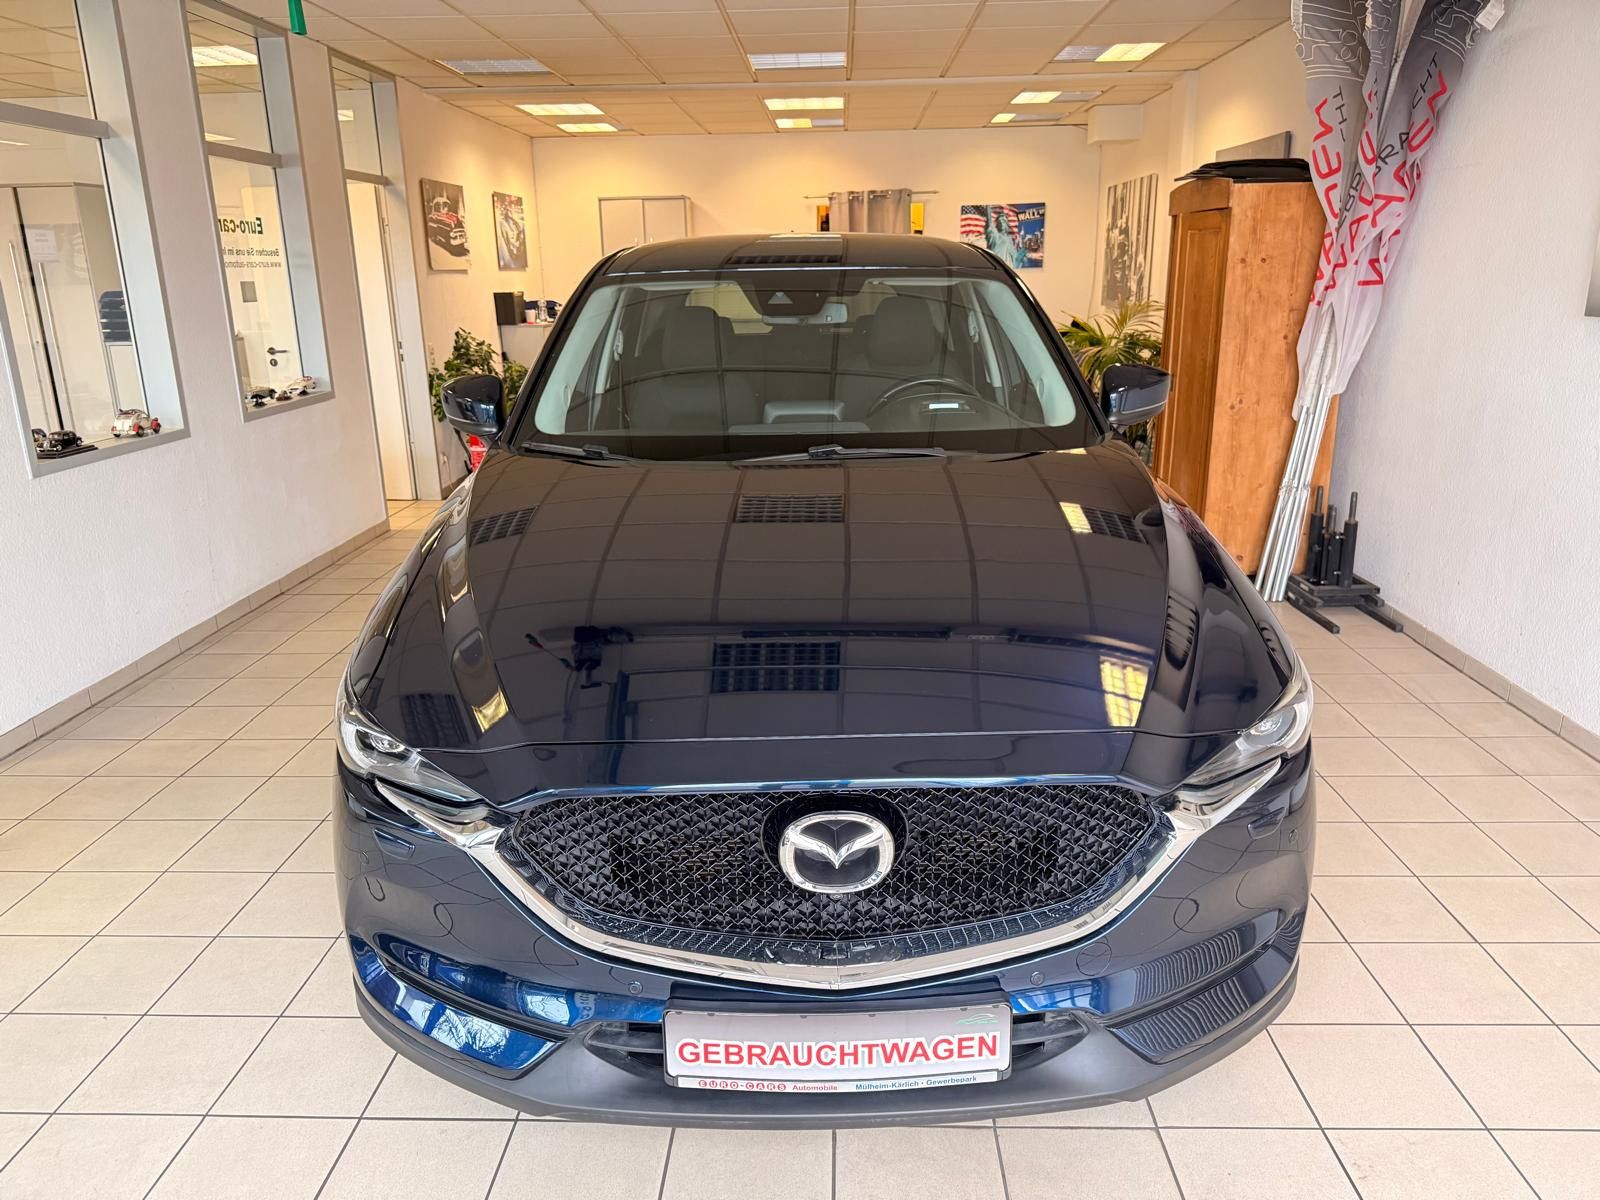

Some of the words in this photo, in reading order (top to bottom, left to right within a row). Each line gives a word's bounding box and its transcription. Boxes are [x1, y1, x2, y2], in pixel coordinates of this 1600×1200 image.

[1018, 208, 1040, 221] WALL
[678, 1034, 998, 1066] GEBRAUCHTWAGEN
[698, 1079, 787, 1092] EURO-CARS
[792, 1083, 838, 1092] Automobile
[855, 1080, 919, 1091] Mülheim-Kärlich
[926, 1074, 977, 1087] Gewerbepark
